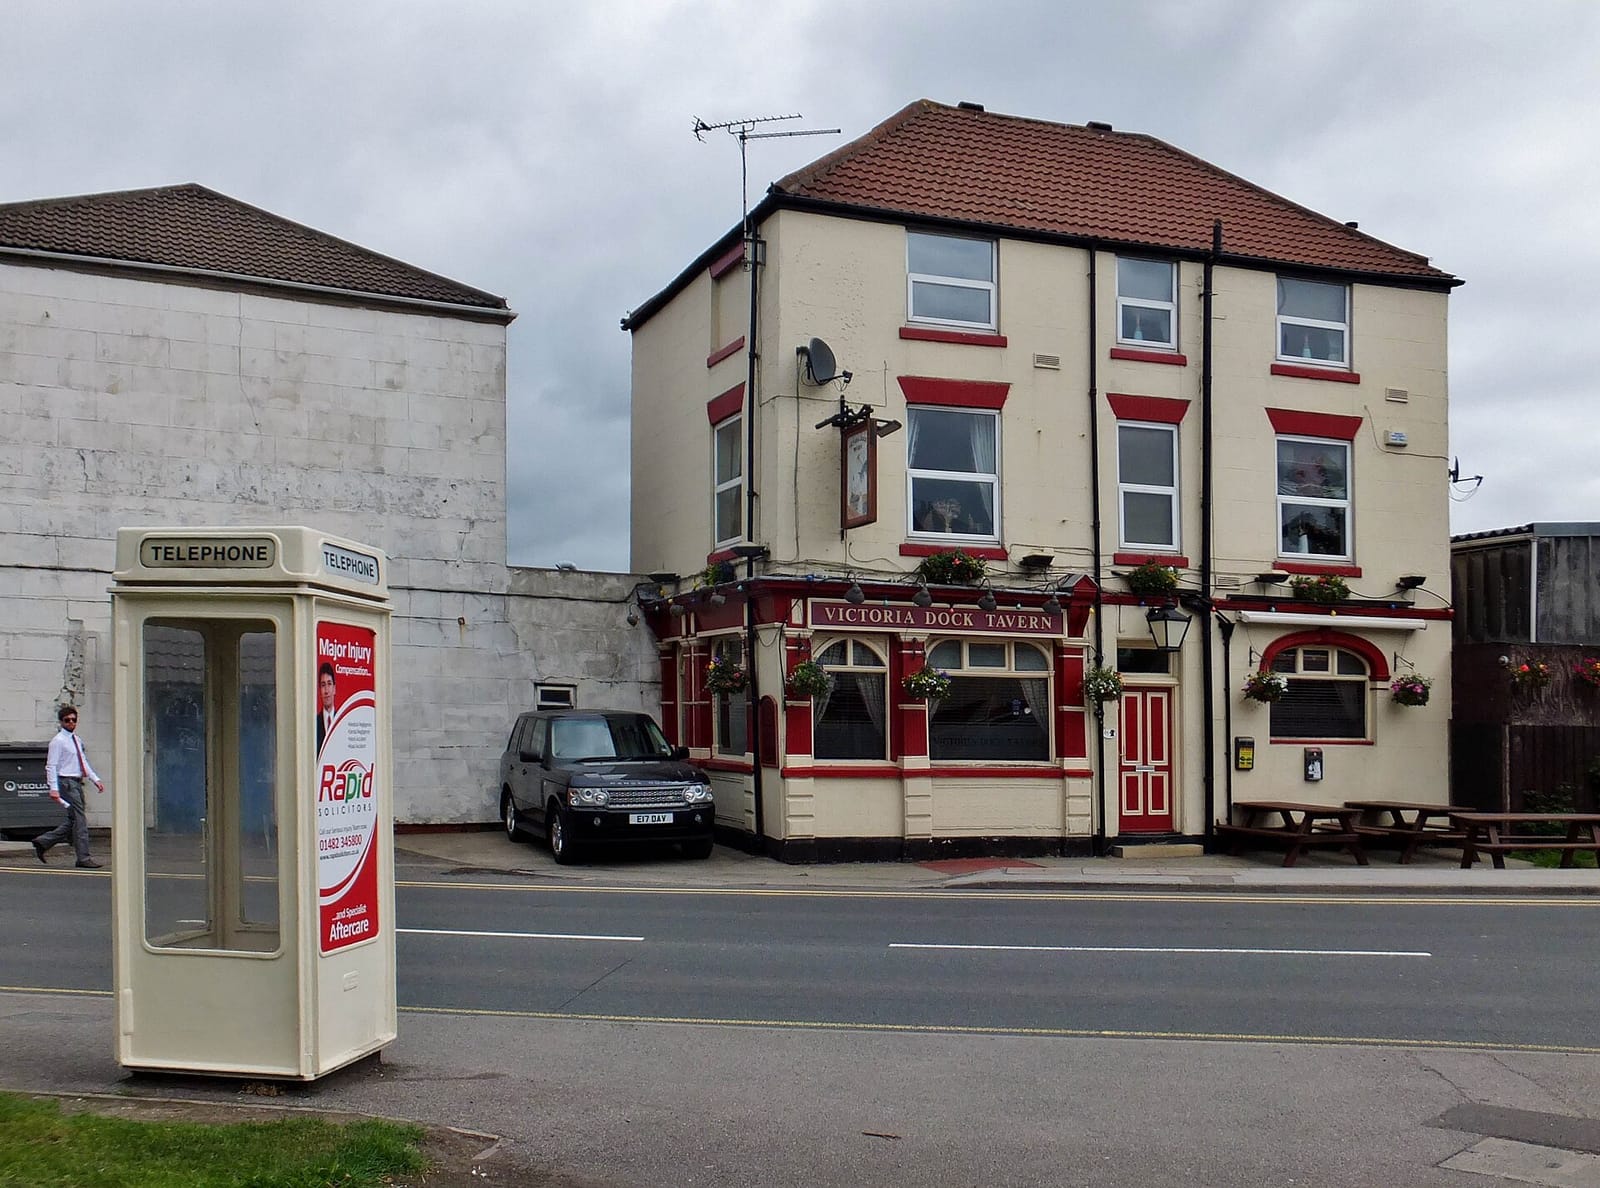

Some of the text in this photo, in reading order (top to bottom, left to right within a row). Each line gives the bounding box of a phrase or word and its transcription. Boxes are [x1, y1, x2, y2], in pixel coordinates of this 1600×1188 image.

[151, 545, 268, 562] TELEPHONE
[323, 551, 375, 578] TELEPHONE
[824, 607, 1052, 629] VICTORIA DOCK TAVERN
[319, 638, 372, 664] Major Injury
[319, 763, 374, 803] Rapid
[318, 803, 371, 816] SOLICITORS
[636, 815, 650, 823] E17
[319, 837, 339, 851] 01482
[346, 903, 367, 919] Specialist
[329, 918, 369, 942] Aftercare
